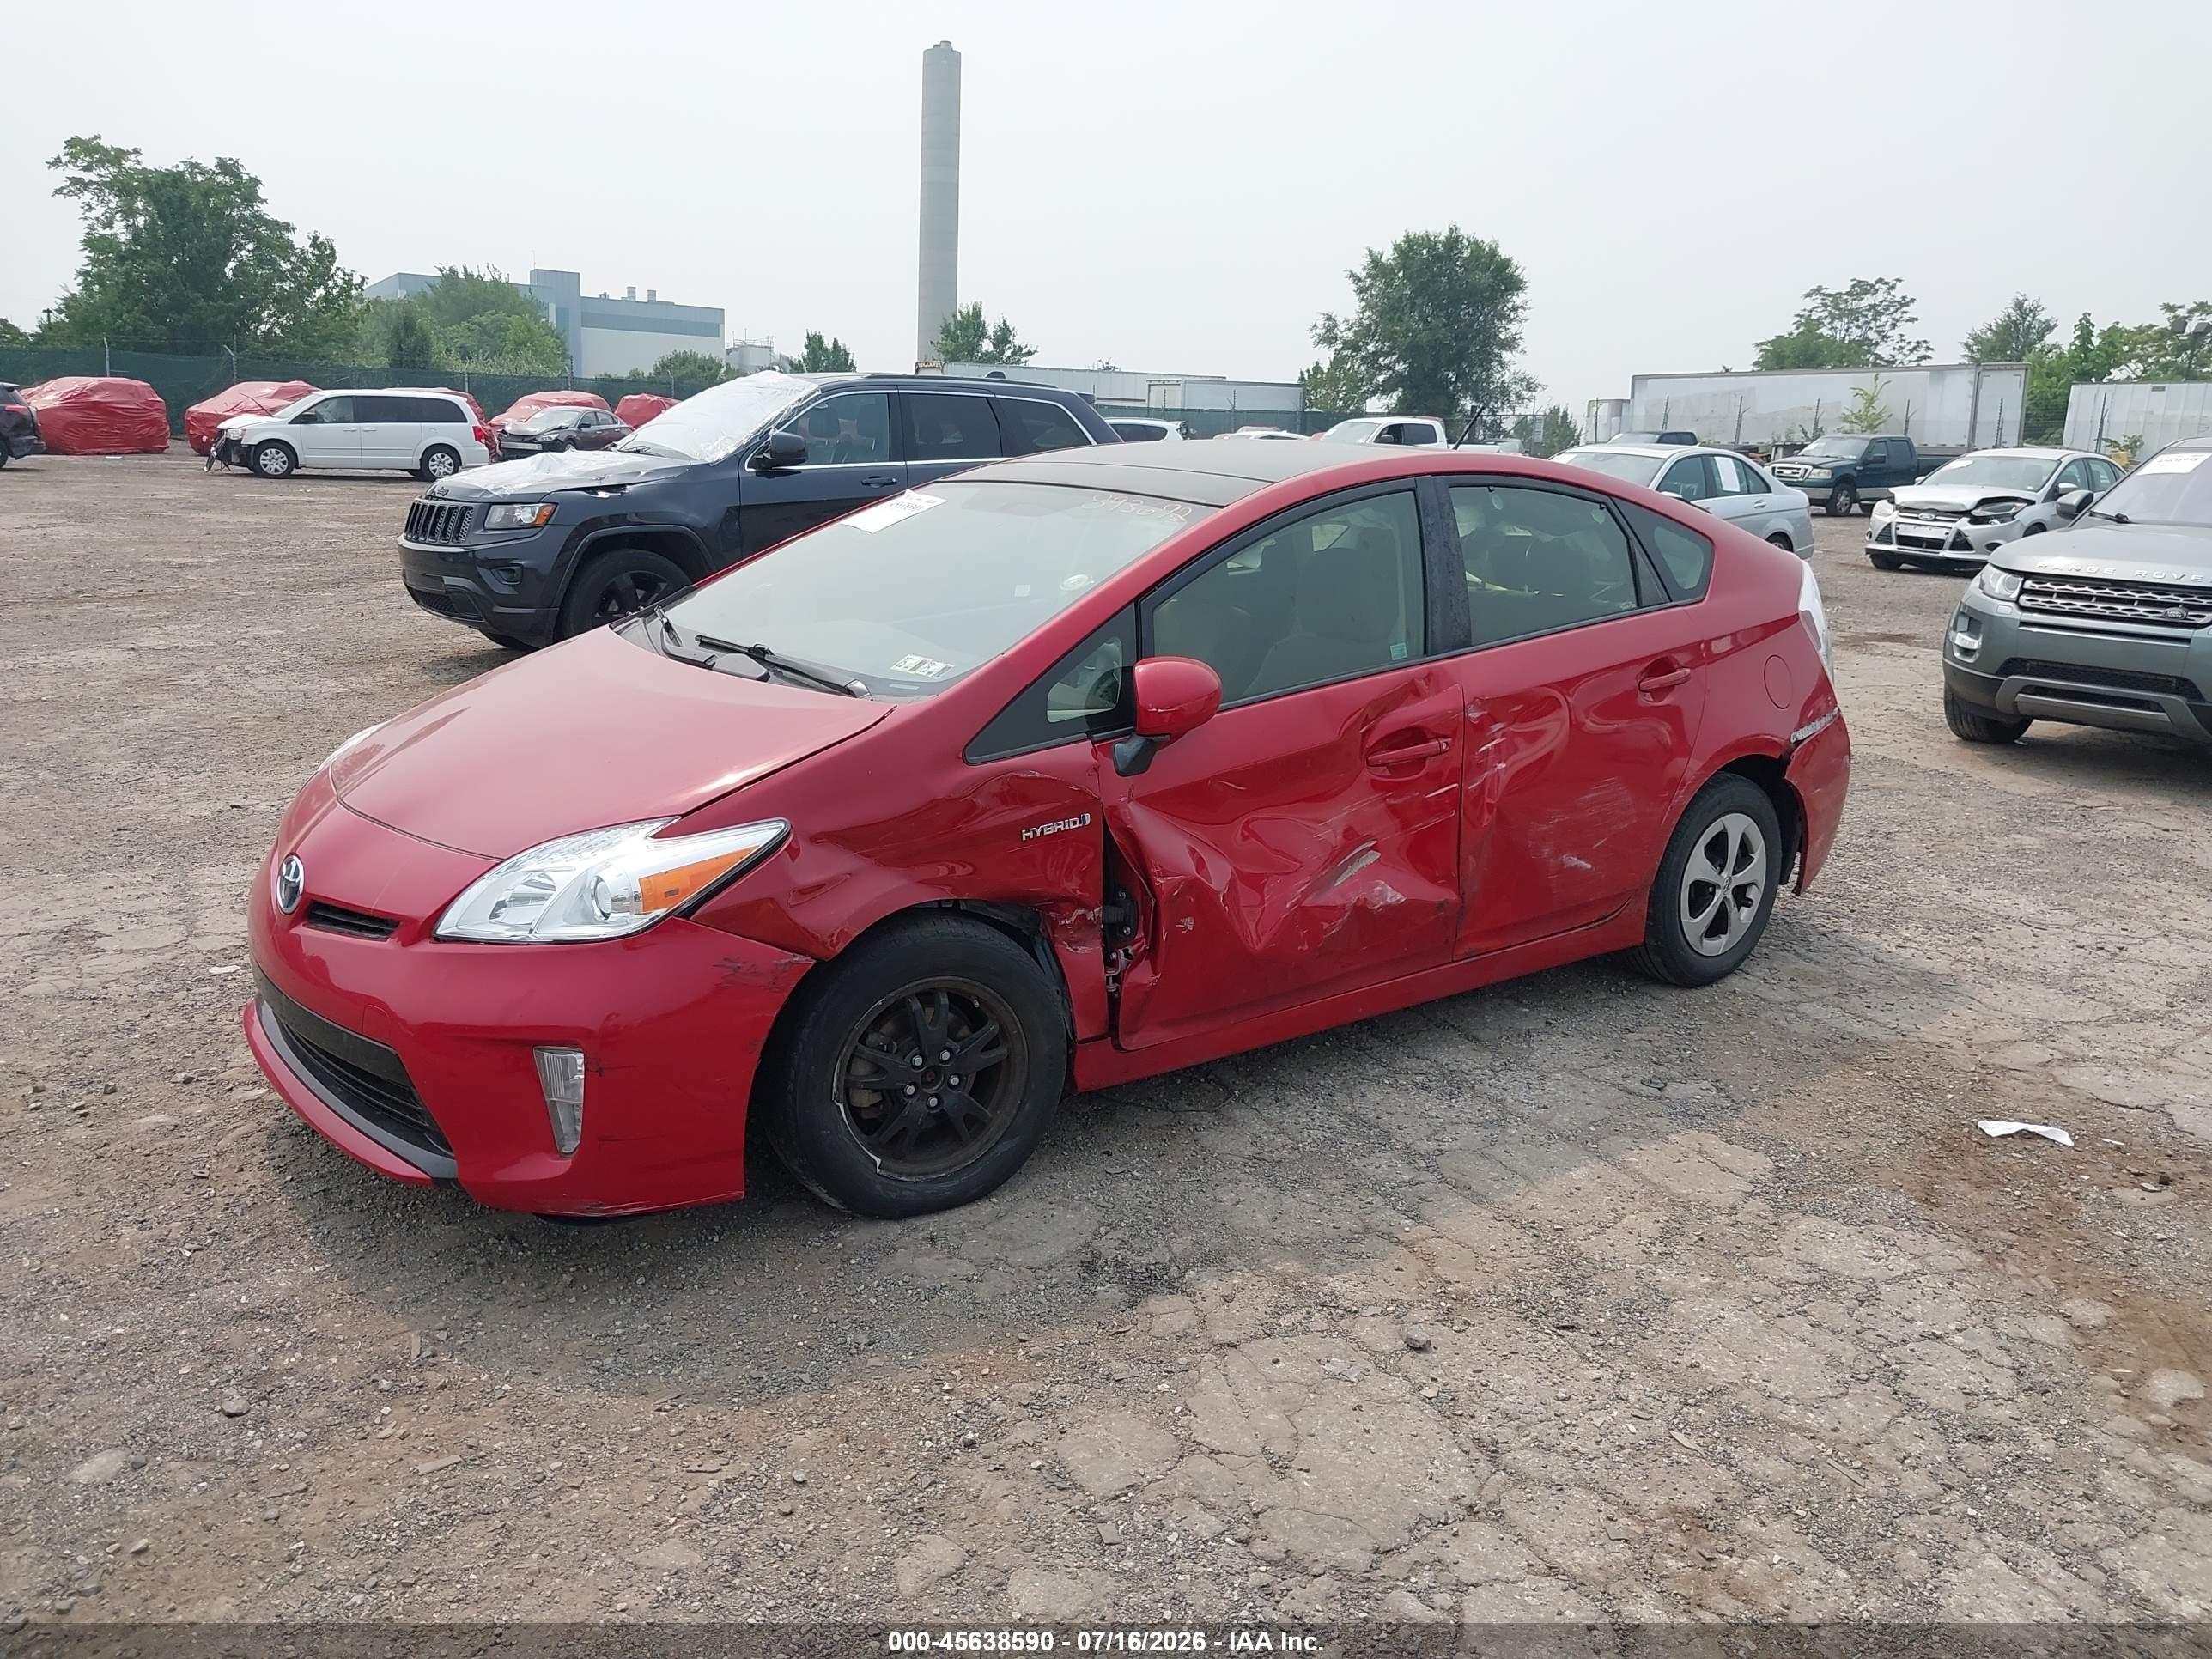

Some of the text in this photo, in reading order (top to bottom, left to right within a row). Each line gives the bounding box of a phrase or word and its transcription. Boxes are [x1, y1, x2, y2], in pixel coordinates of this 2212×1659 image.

[2035, 562, 2212, 583] RANGE ROVE
[1022, 817, 1084, 842] HYBRID
